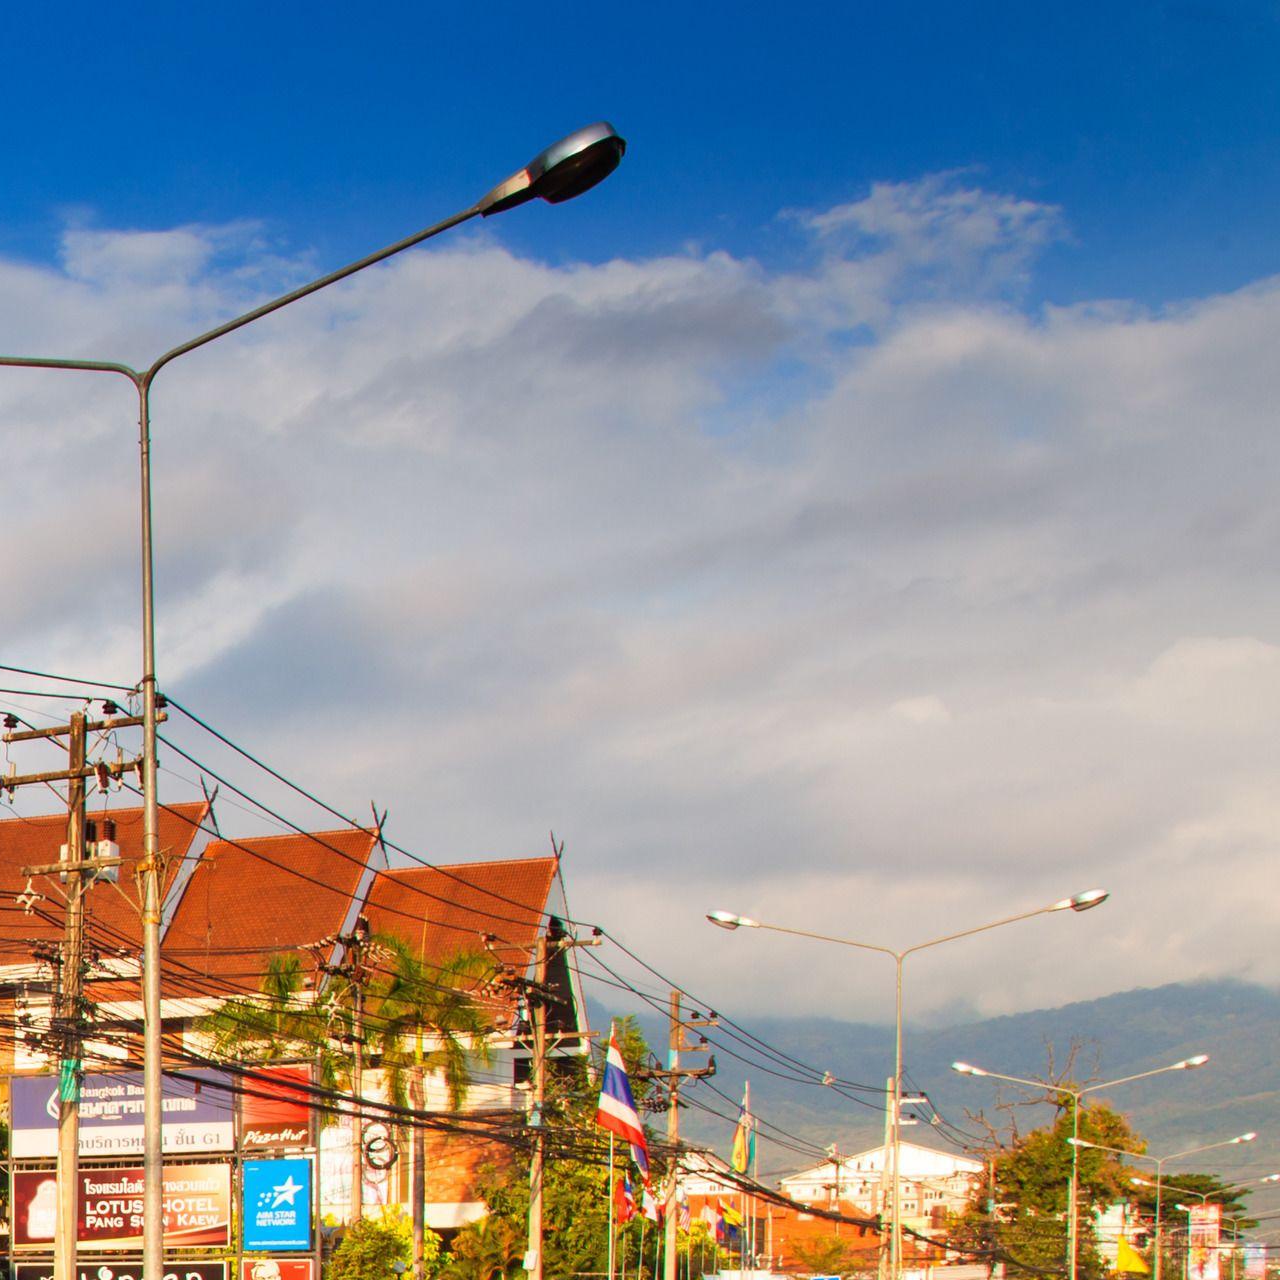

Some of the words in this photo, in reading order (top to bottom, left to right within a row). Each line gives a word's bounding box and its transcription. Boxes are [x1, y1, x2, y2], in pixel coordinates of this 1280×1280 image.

[175, 1128, 195, 1145] ชั้น
[203, 1133, 221, 1145] G1
[243, 1130, 280, 1145] Pizza
[280, 1128, 308, 1141] Hut
[85, 1199, 144, 1214] LOTUS
[162, 1198, 220, 1212] HOTEL
[85, 1216, 124, 1228] PANG
[177, 1213, 220, 1226] KAEW
[256, 1211, 273, 1219] AIM
[275, 1210, 296, 1219] STAR
[256, 1219, 296, 1227] NETWORK
